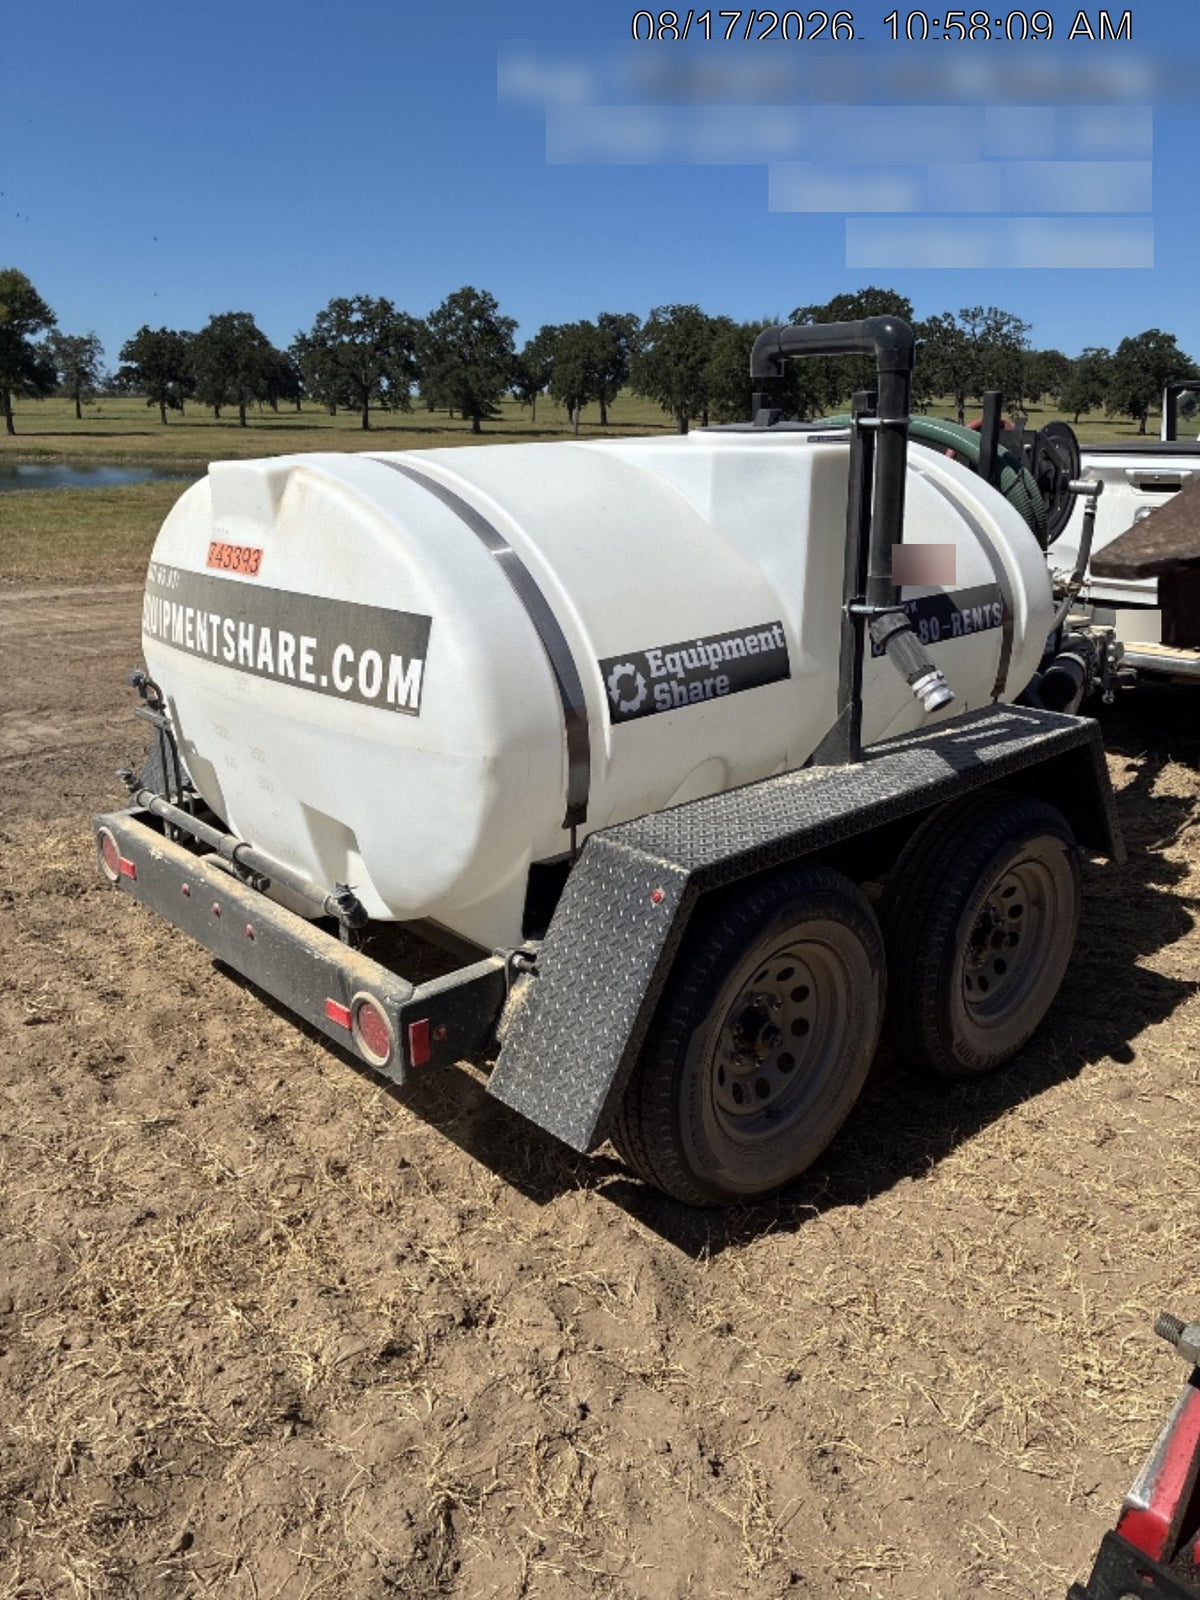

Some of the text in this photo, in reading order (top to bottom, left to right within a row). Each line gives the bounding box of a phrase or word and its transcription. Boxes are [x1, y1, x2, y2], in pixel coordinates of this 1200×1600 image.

[208, 541, 261, 574] 743393
[918, 601, 1003, 645] 80-RENTS
[644, 625, 785, 679] Equipment
[653, 673, 730, 712] Share
